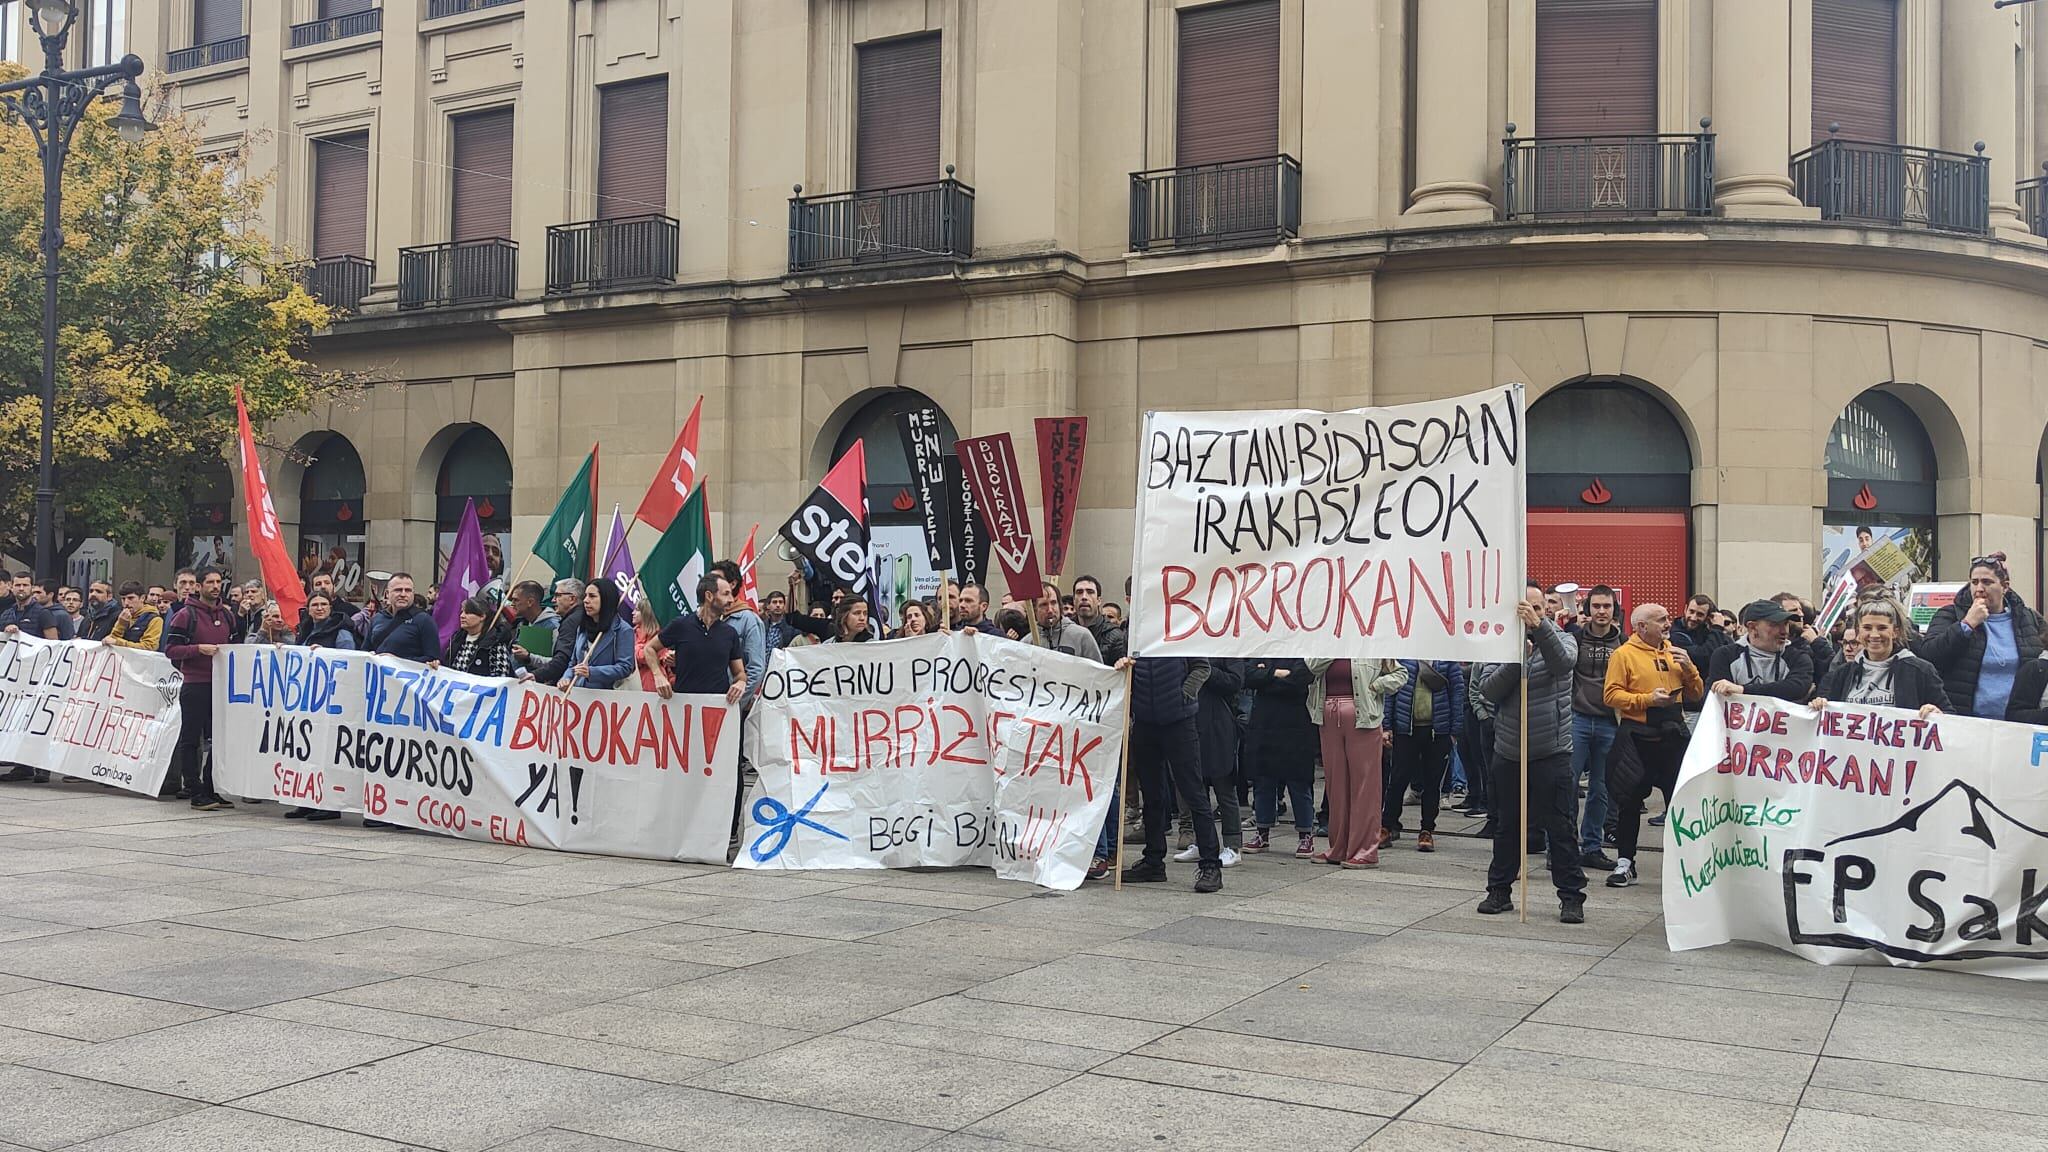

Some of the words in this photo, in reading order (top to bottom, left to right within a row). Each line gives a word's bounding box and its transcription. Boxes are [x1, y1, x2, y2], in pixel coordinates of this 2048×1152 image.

[979, 440, 1024, 563] BUROKRAZIA
[1193, 473, 1489, 555] IRAKASLEOK
[1161, 549, 1505, 643] BORROKAN!!!
[91, 762, 133, 785] donibane
[334, 724, 475, 797] RECURSOS
[514, 762, 585, 826] YA!
[417, 795, 466, 832] CCOO
[490, 815, 529, 847] ELA
